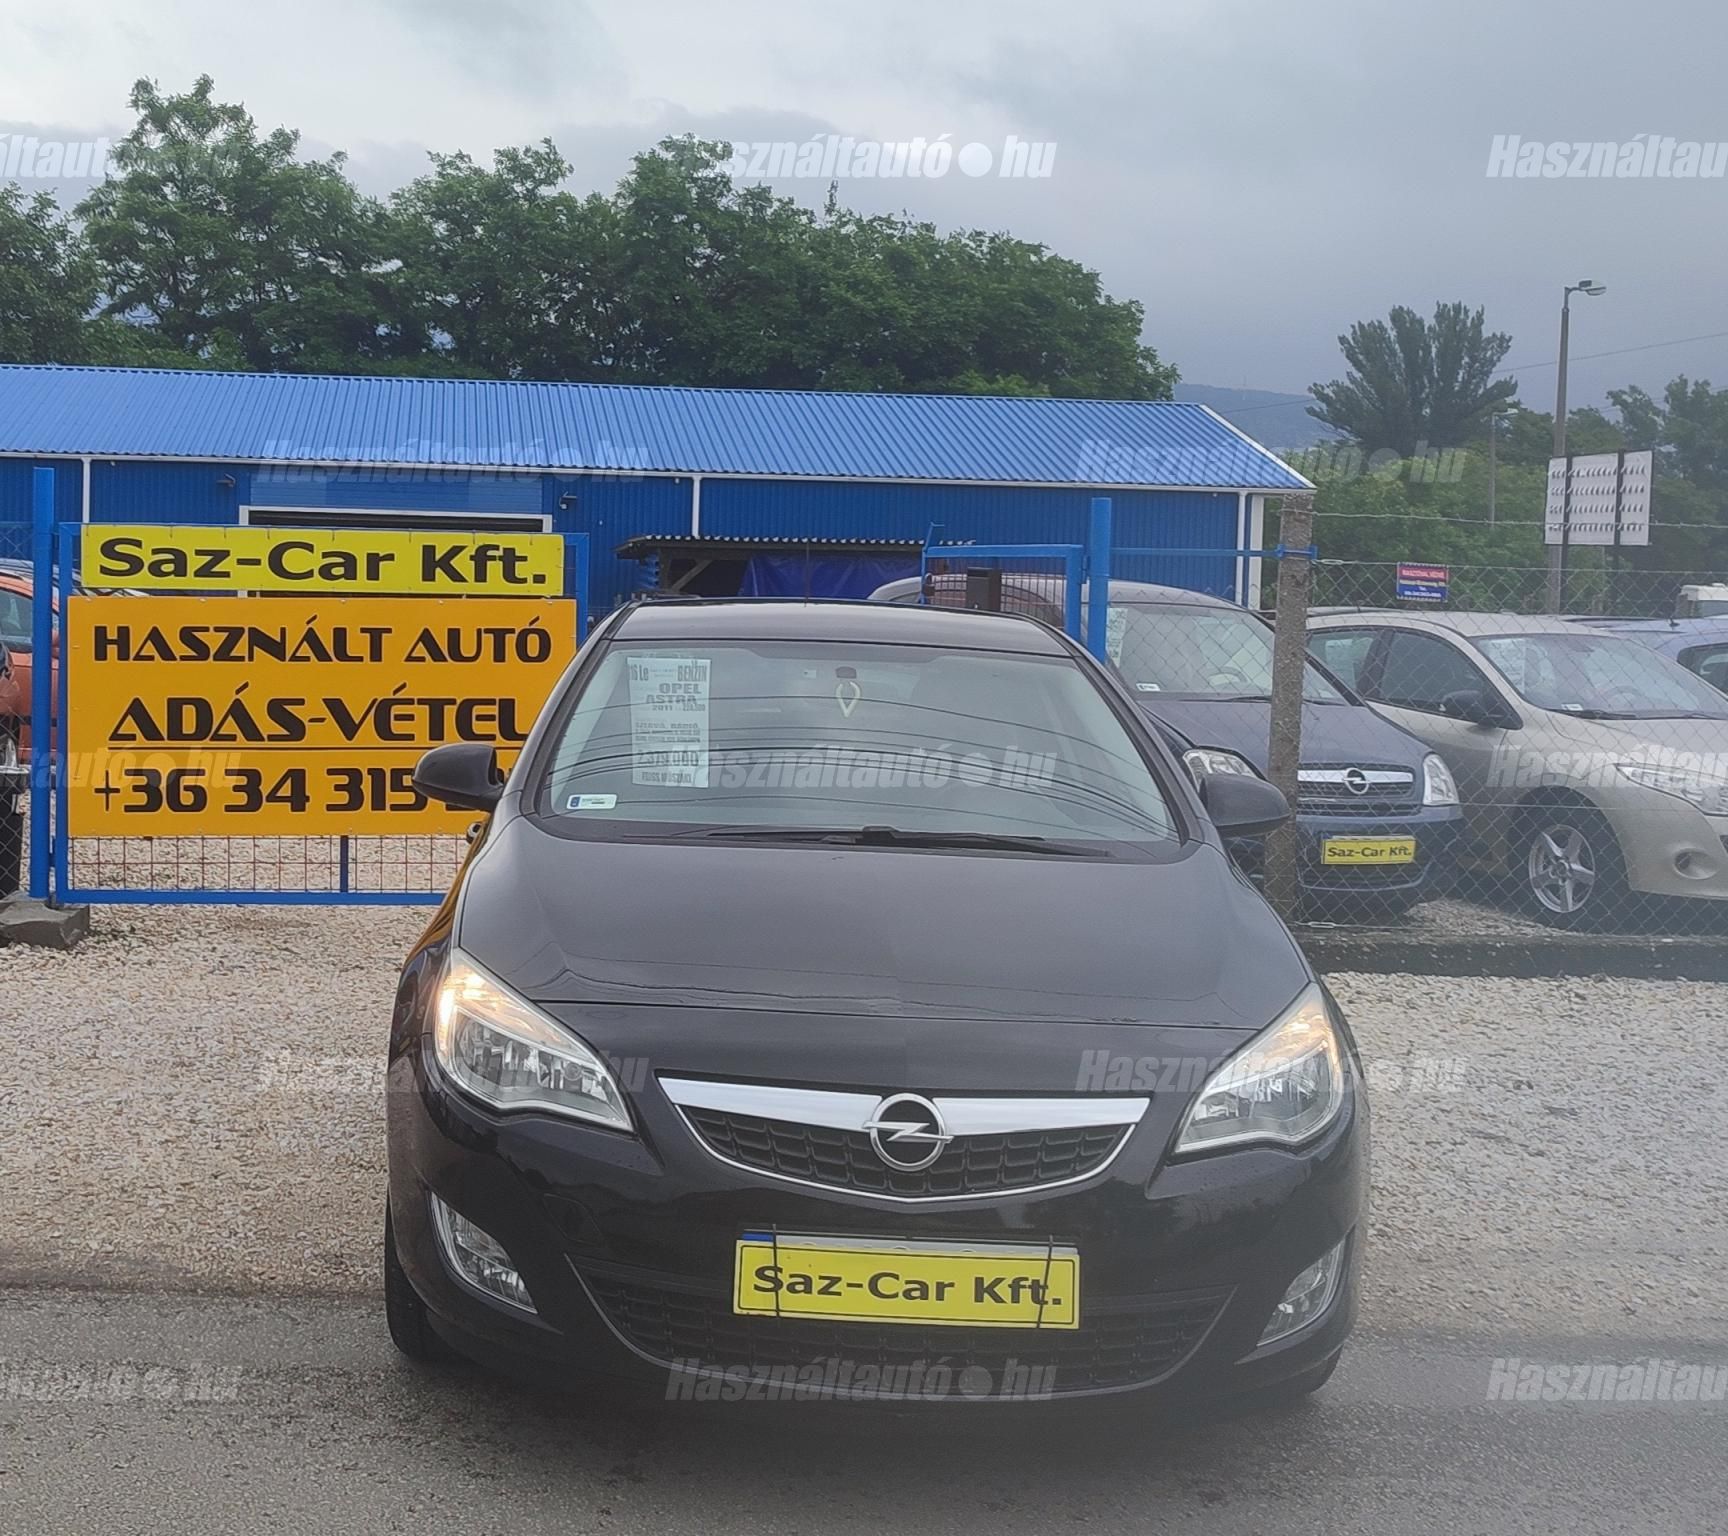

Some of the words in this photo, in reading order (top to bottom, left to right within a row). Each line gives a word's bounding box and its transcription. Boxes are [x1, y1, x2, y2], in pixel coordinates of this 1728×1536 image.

[98, 538, 394, 581] Saz-Car
[420, 543, 547, 585] Kft.
[94, 614, 392, 662] HASZNÁLT
[404, 616, 553, 663] AUTÓ
[646, 694, 698, 705] ASTRA
[659, 683, 702, 694] OPEL
[108, 681, 529, 742] ADÁS-VÉTEL
[93, 768, 208, 812] +36
[224, 768, 310, 812] 34
[325, 768, 429, 812] 315
[1327, 846, 1386, 857] Saz-Car
[1389, 846, 1412, 857] Kft.
[752, 1266, 956, 1303] Saz-Car
[973, 1275, 1063, 1306] Kft.
